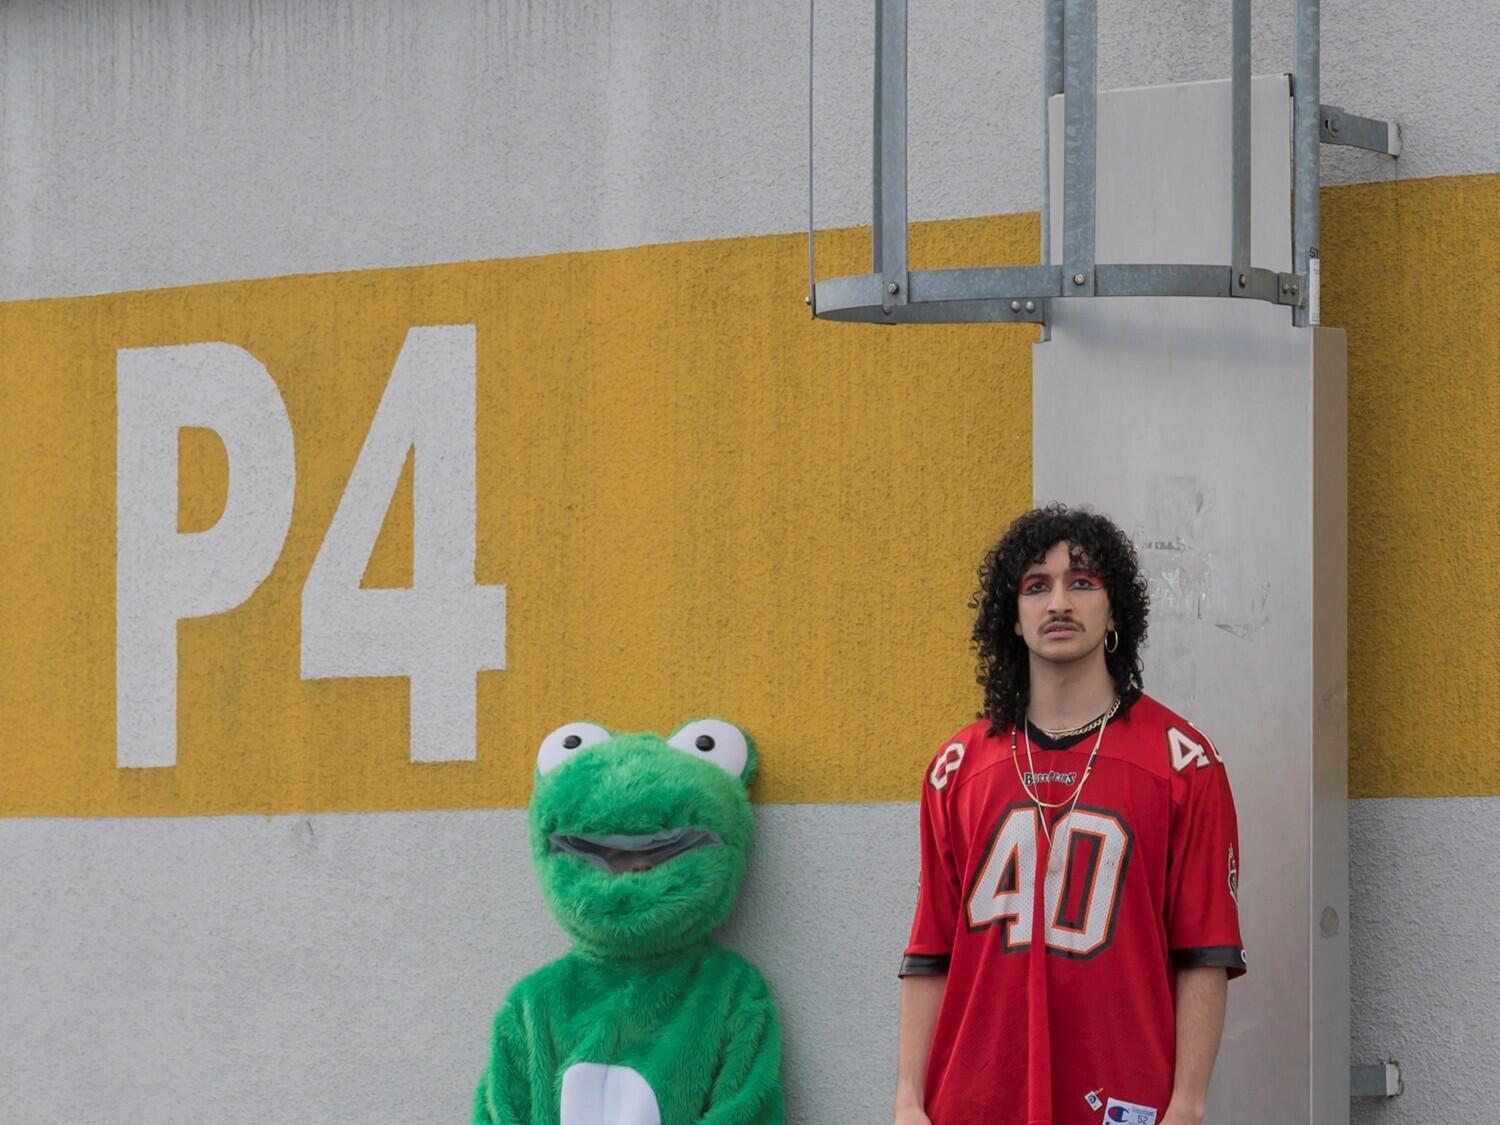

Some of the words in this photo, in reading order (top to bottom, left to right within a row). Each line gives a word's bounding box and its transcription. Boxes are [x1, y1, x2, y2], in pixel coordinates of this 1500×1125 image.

[116, 323, 506, 768] P4
[964, 800, 1135, 961] 40
[1137, 1114, 1149, 1125] 52
